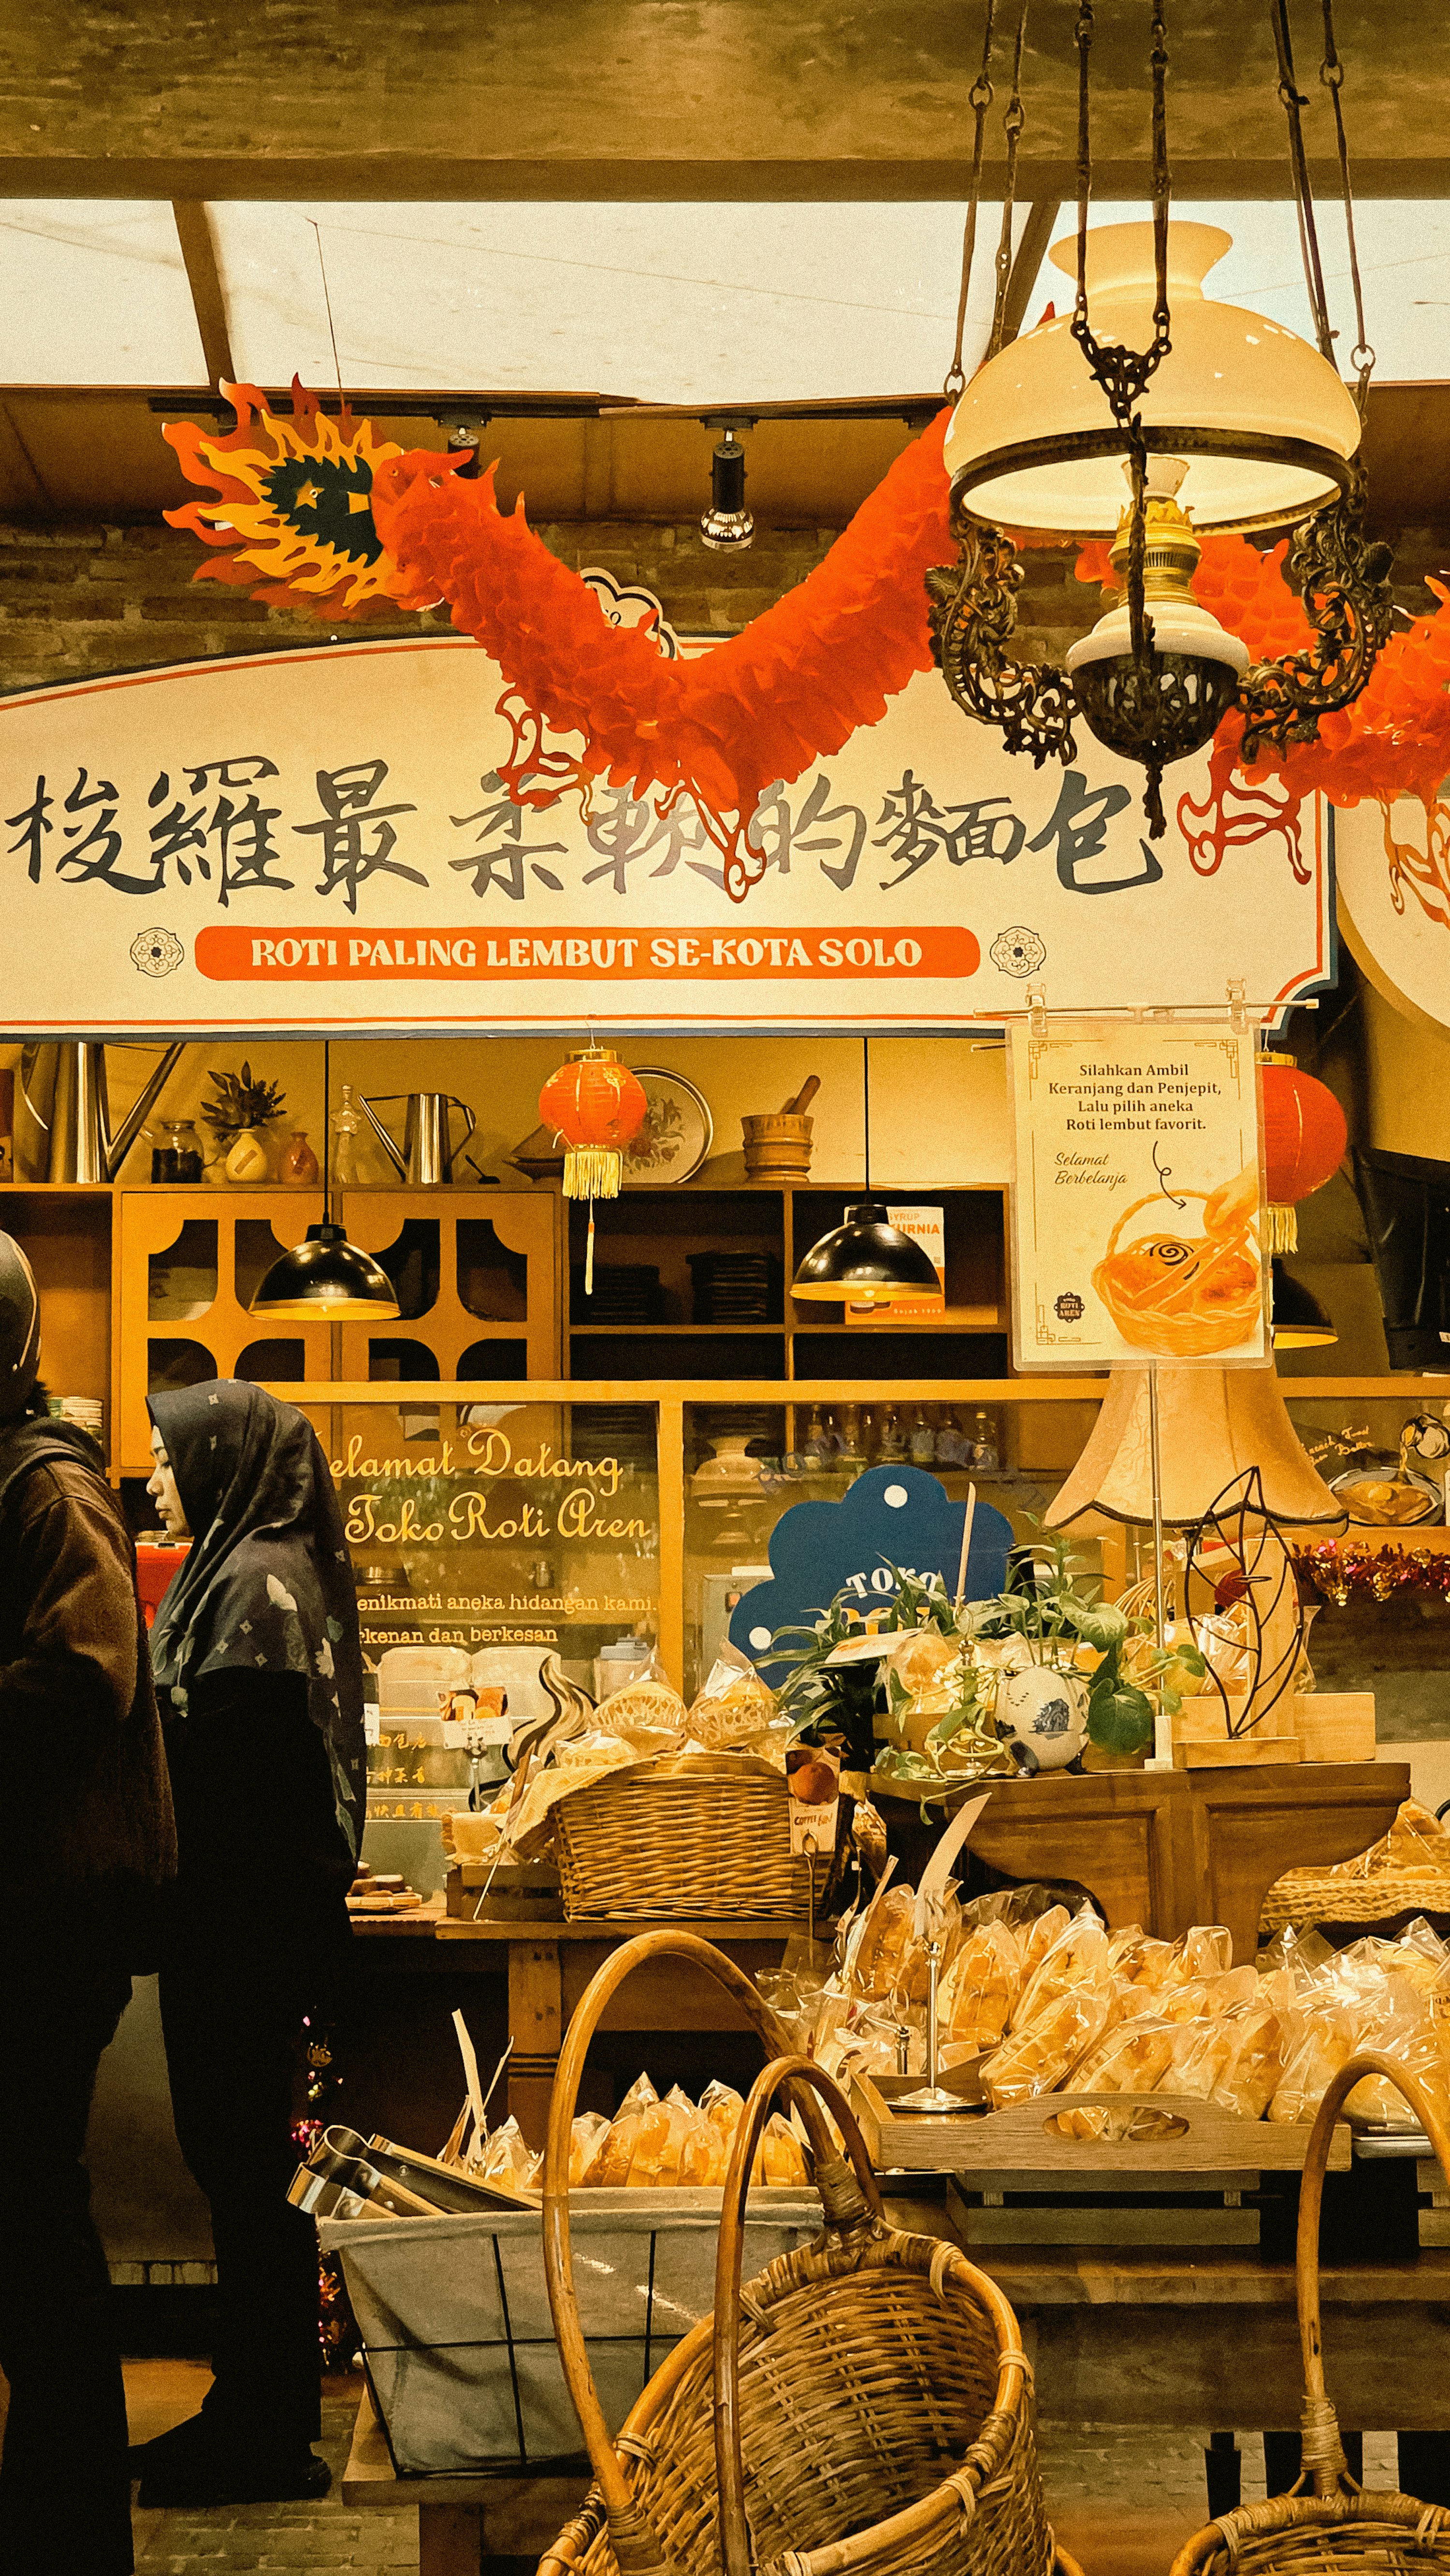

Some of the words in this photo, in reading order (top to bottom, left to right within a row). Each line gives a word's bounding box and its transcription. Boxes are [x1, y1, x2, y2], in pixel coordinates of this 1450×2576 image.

[251, 938, 338, 967] ROTI
[348, 939, 476, 967] PALING
[487, 938, 638, 967] LEMBUT
[650, 938, 813, 967] SE-KOTA
[818, 938, 923, 967] SOLO
[1079, 1064, 1142, 1076] Silahkan
[1146, 1064, 1189, 1076] Ambil
[1048, 1082, 1124, 1097] Keranjang
[1127, 1082, 1153, 1094] dan
[1158, 1082, 1221, 1096] Penjepit,
[1078, 1100, 1109, 1112] Lalu
[1113, 1100, 1146, 1115] pilih
[1149, 1100, 1193, 1112] aneka
[1066, 1119, 1096, 1130] Roti
[1100, 1118, 1151, 1130] lembut
[1155, 1118, 1206, 1130] favorit.
[1054, 1152, 1109, 1166] Selamat
[1054, 1170, 1128, 1191] Berbelanja
[329, 1434, 455, 1478] elamat
[467, 1428, 624, 1497] Datang
[345, 1494, 445, 1543] Toko
[448, 1491, 551, 1540] Roti
[556, 1487, 651, 1538] Aren
[357, 1593, 442, 1611] enikmati
[447, 1595, 505, 1611] aneka
[508, 1593, 599, 1615] hidangan
[603, 1596, 657, 1611] kami.
[428, 1628, 464, 1644] dan
[470, 1626, 558, 1642] berkesan
